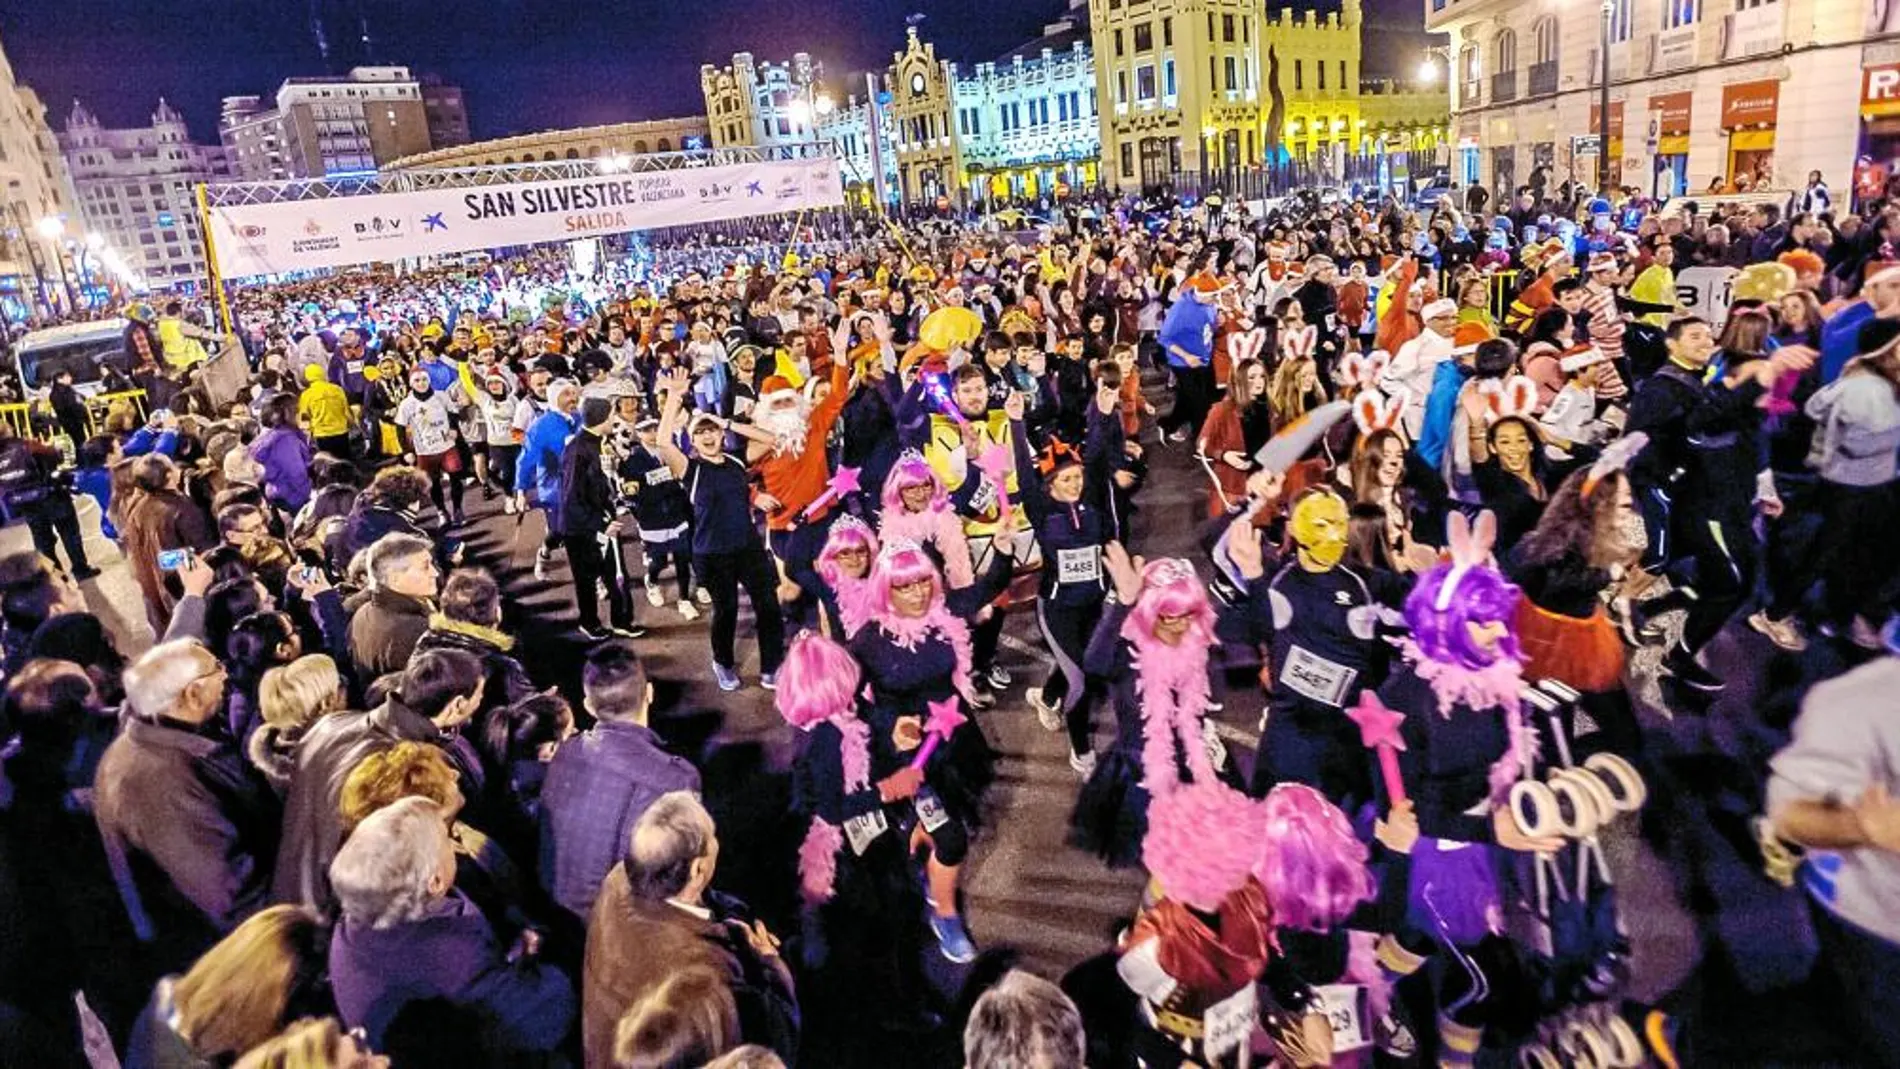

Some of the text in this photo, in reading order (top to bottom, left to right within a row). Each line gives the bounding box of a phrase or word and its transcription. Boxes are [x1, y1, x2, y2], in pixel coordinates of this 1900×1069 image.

[464, 180, 635, 220] SAN SILVESTRE
[565, 211, 628, 232] SALIDA
[1331, 1008, 1351, 1032] 29
